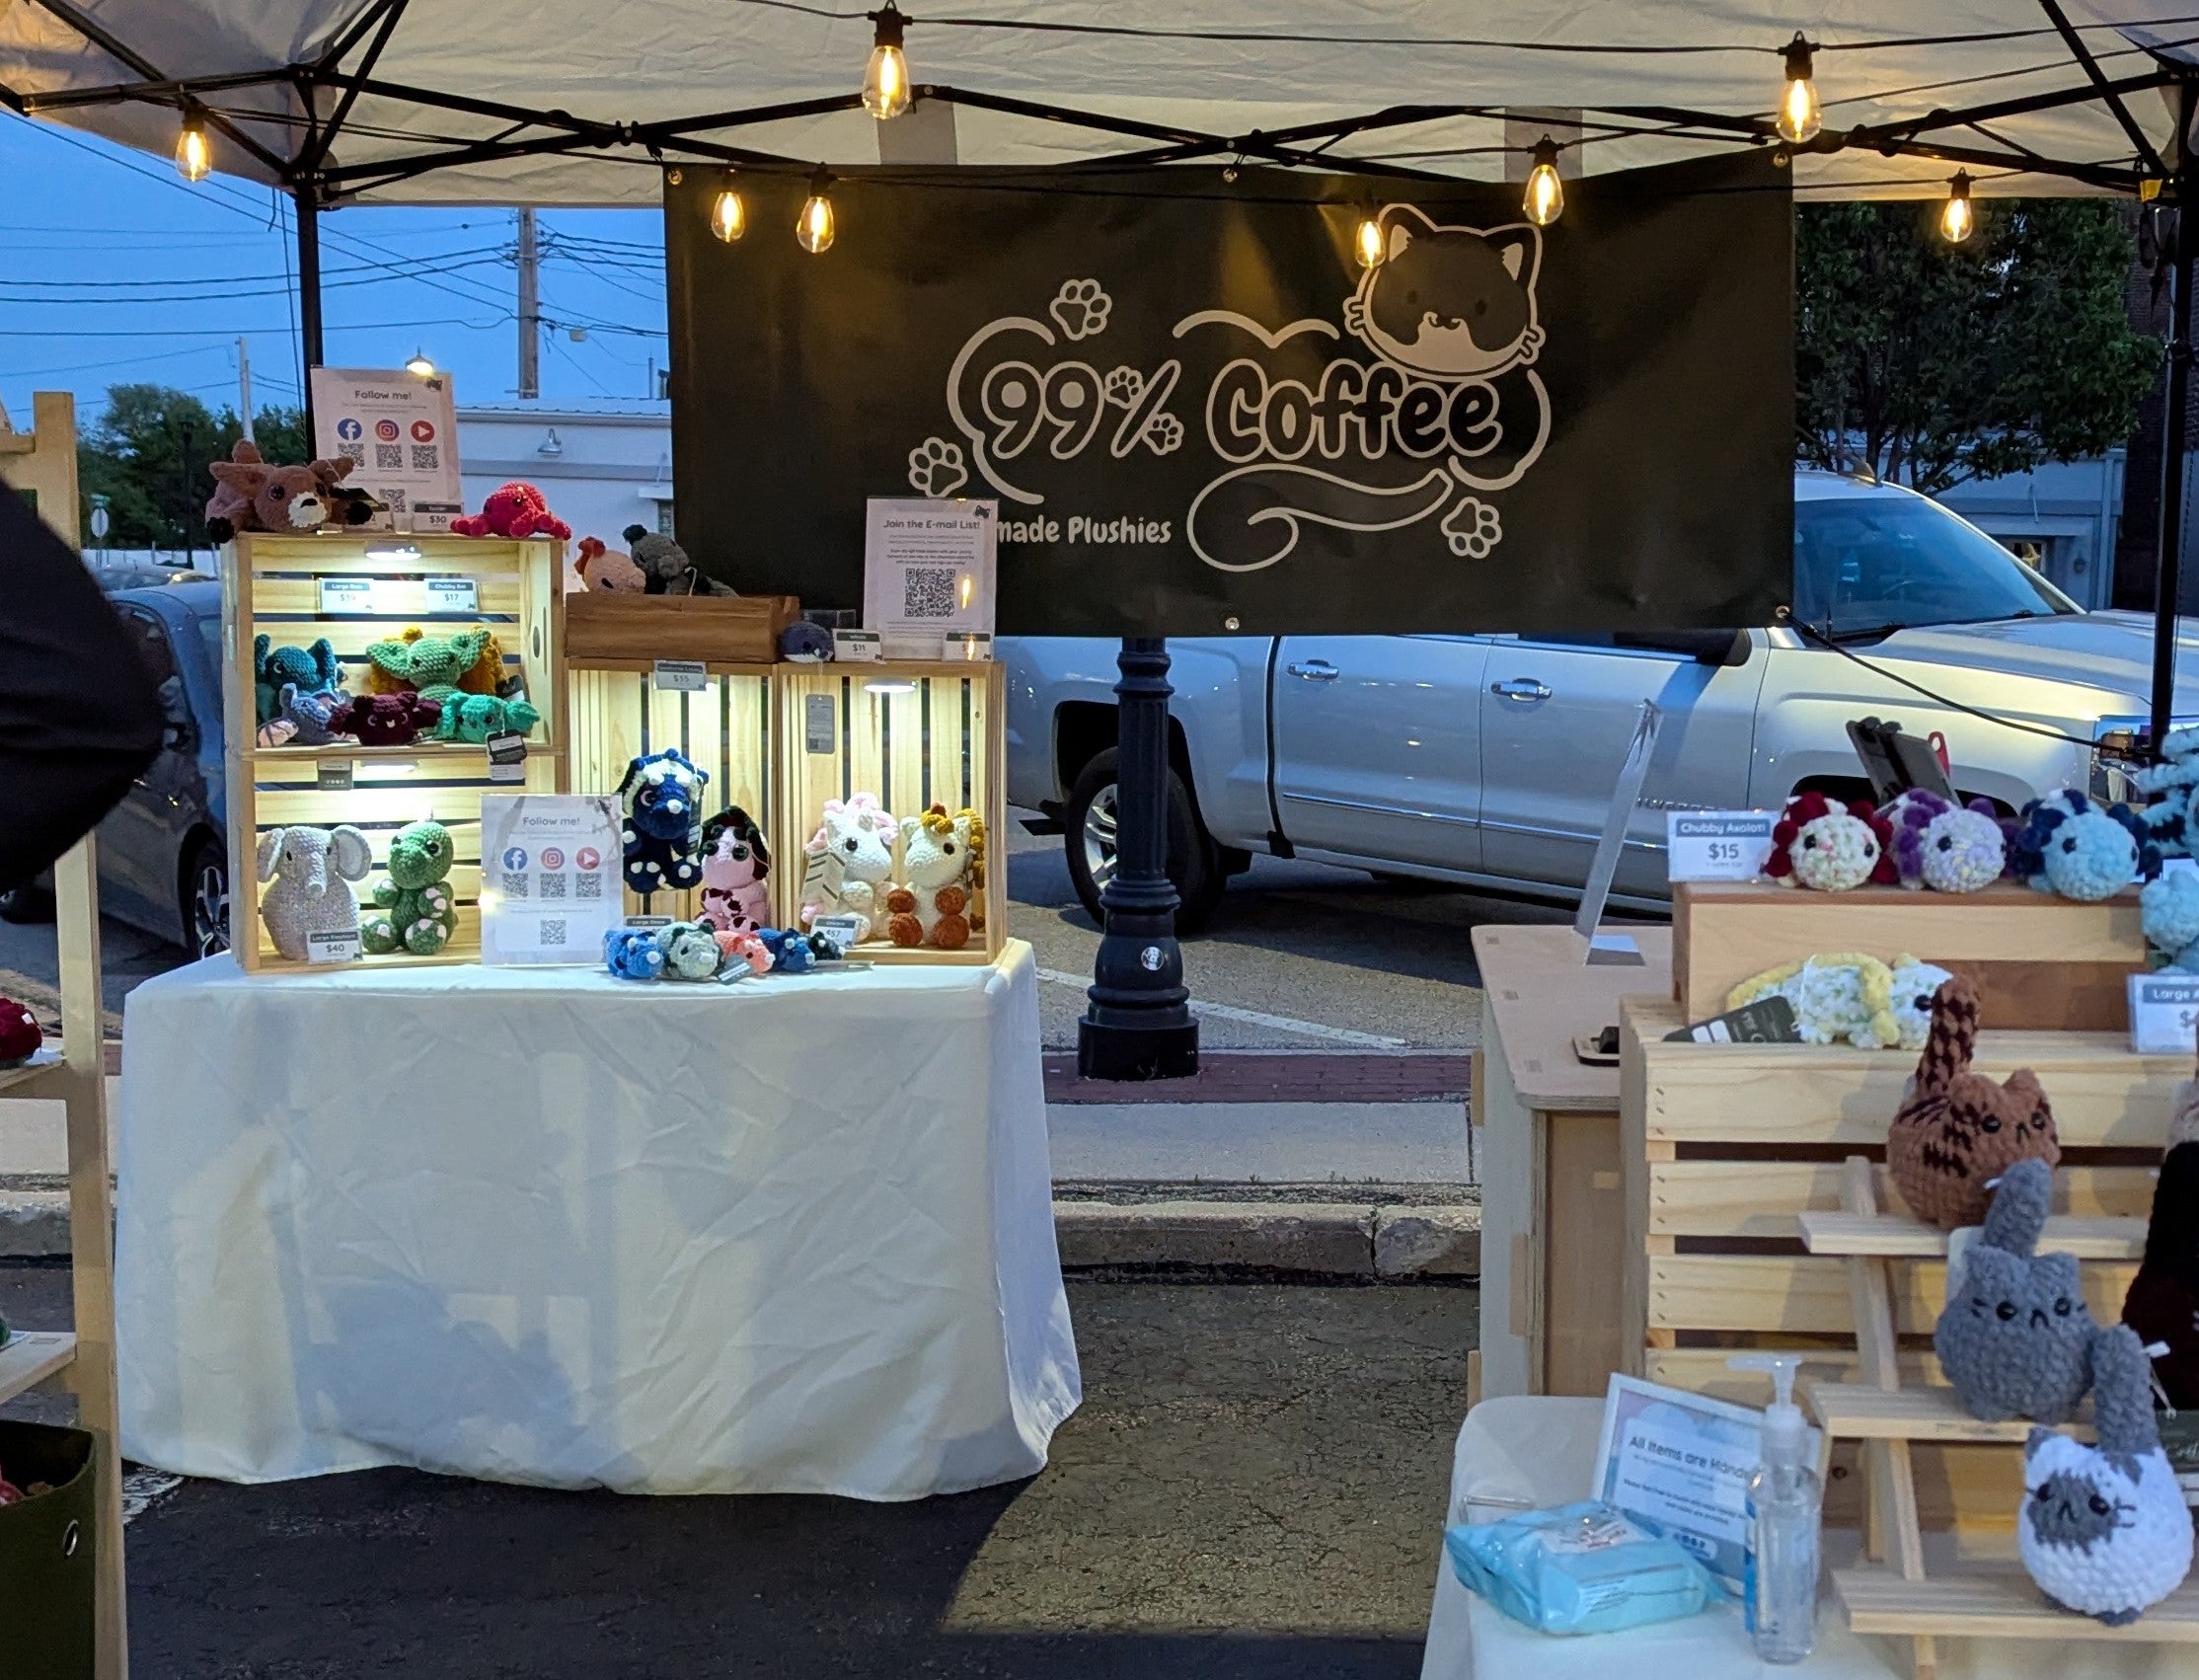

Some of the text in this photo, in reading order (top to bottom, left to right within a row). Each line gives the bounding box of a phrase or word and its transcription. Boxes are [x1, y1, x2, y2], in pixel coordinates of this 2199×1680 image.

[354, 390, 413, 401] Follow me!
[981, 358, 1503, 463] 99% Coffee
[883, 519, 980, 530] Join the E-mail List!
[1068, 515, 1173, 545] Plushies
[522, 816, 580, 826] Follow me!
[1680, 822, 1724, 835] Chubby
[1707, 842, 1739, 861] $15
[326, 944, 345, 954] $40
[2153, 988, 2191, 1002] Large
[1629, 1436, 1646, 1449] All
[1647, 1441, 1683, 1461] Items
[1685, 1453, 1707, 1469] are
